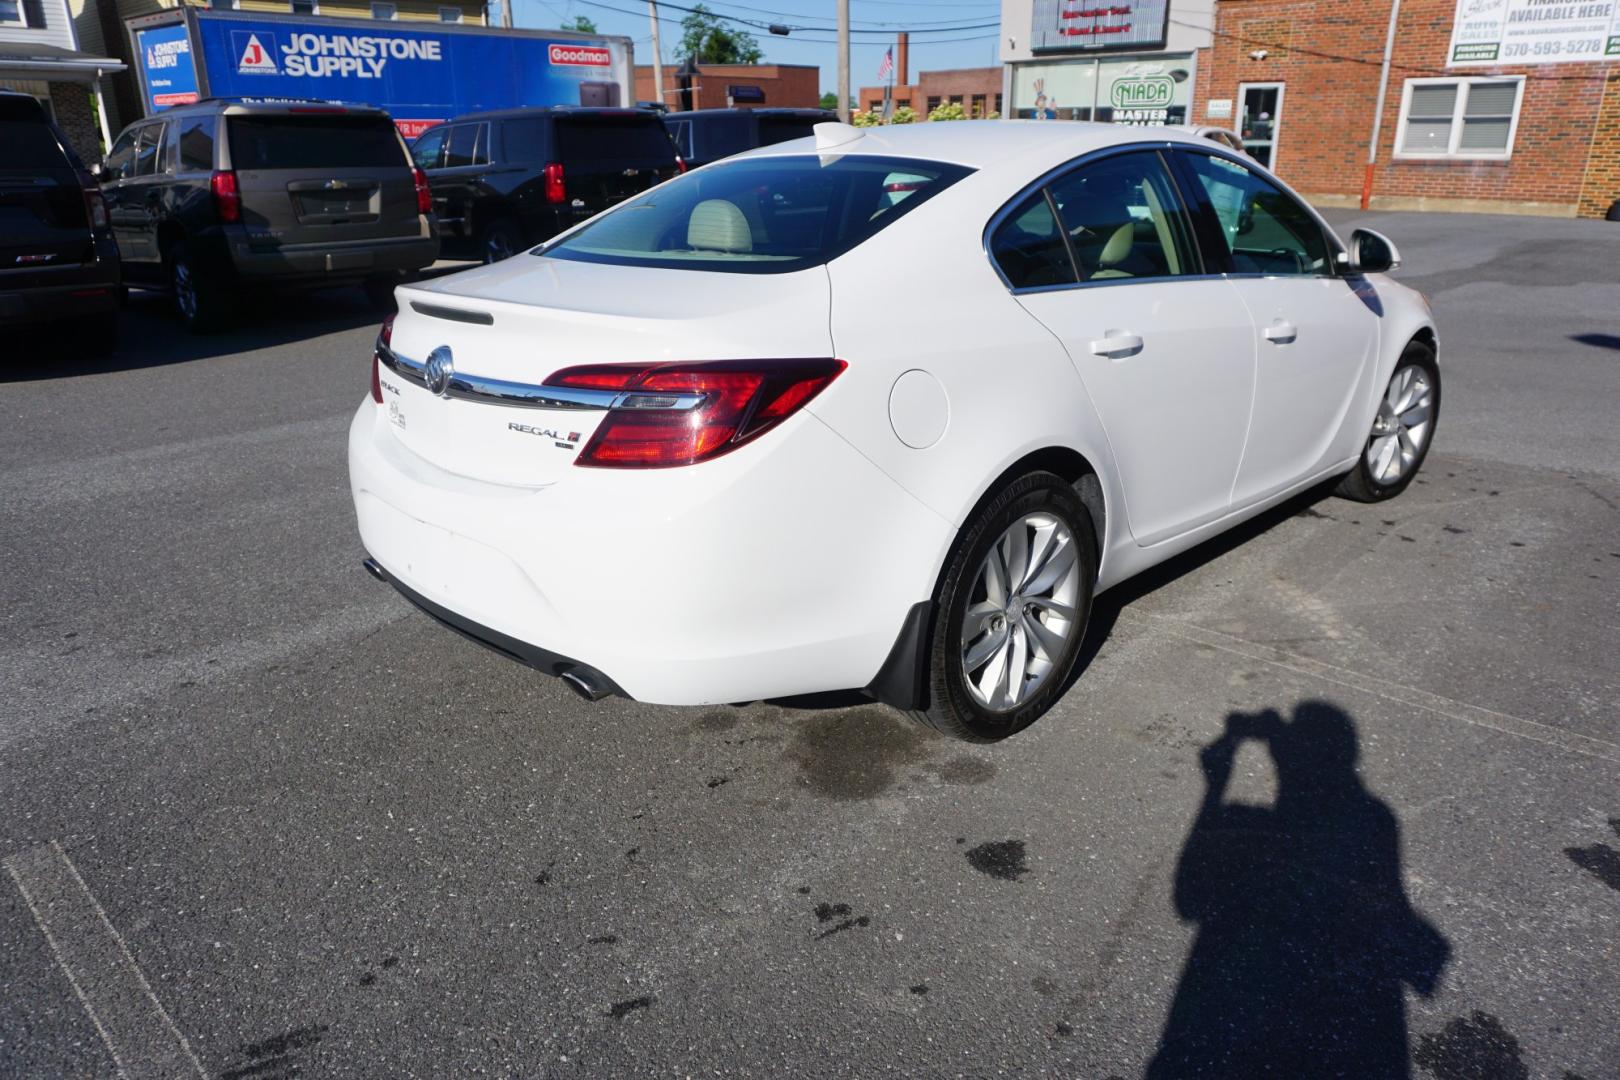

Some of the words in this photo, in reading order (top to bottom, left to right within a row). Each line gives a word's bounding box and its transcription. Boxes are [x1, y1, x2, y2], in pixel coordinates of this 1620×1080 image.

[1508, 6, 1576, 23] AVAILABLE
[1577, 4, 1612, 18] HERE
[1465, 21, 1498, 30] AUTO
[154, 40, 189, 56] JOHNSTONE
[281, 33, 442, 61] JOHNSTONE
[551, 48, 610, 63] Goodman
[1504, 39, 1601, 57] 570-593-5278
[155, 54, 178, 68] SUPPLY
[284, 55, 387, 78] SUPPLY
[1116, 83, 1168, 104] NIADA
[1112, 109, 1168, 120] MASTER
[508, 422, 565, 440] REGAL
